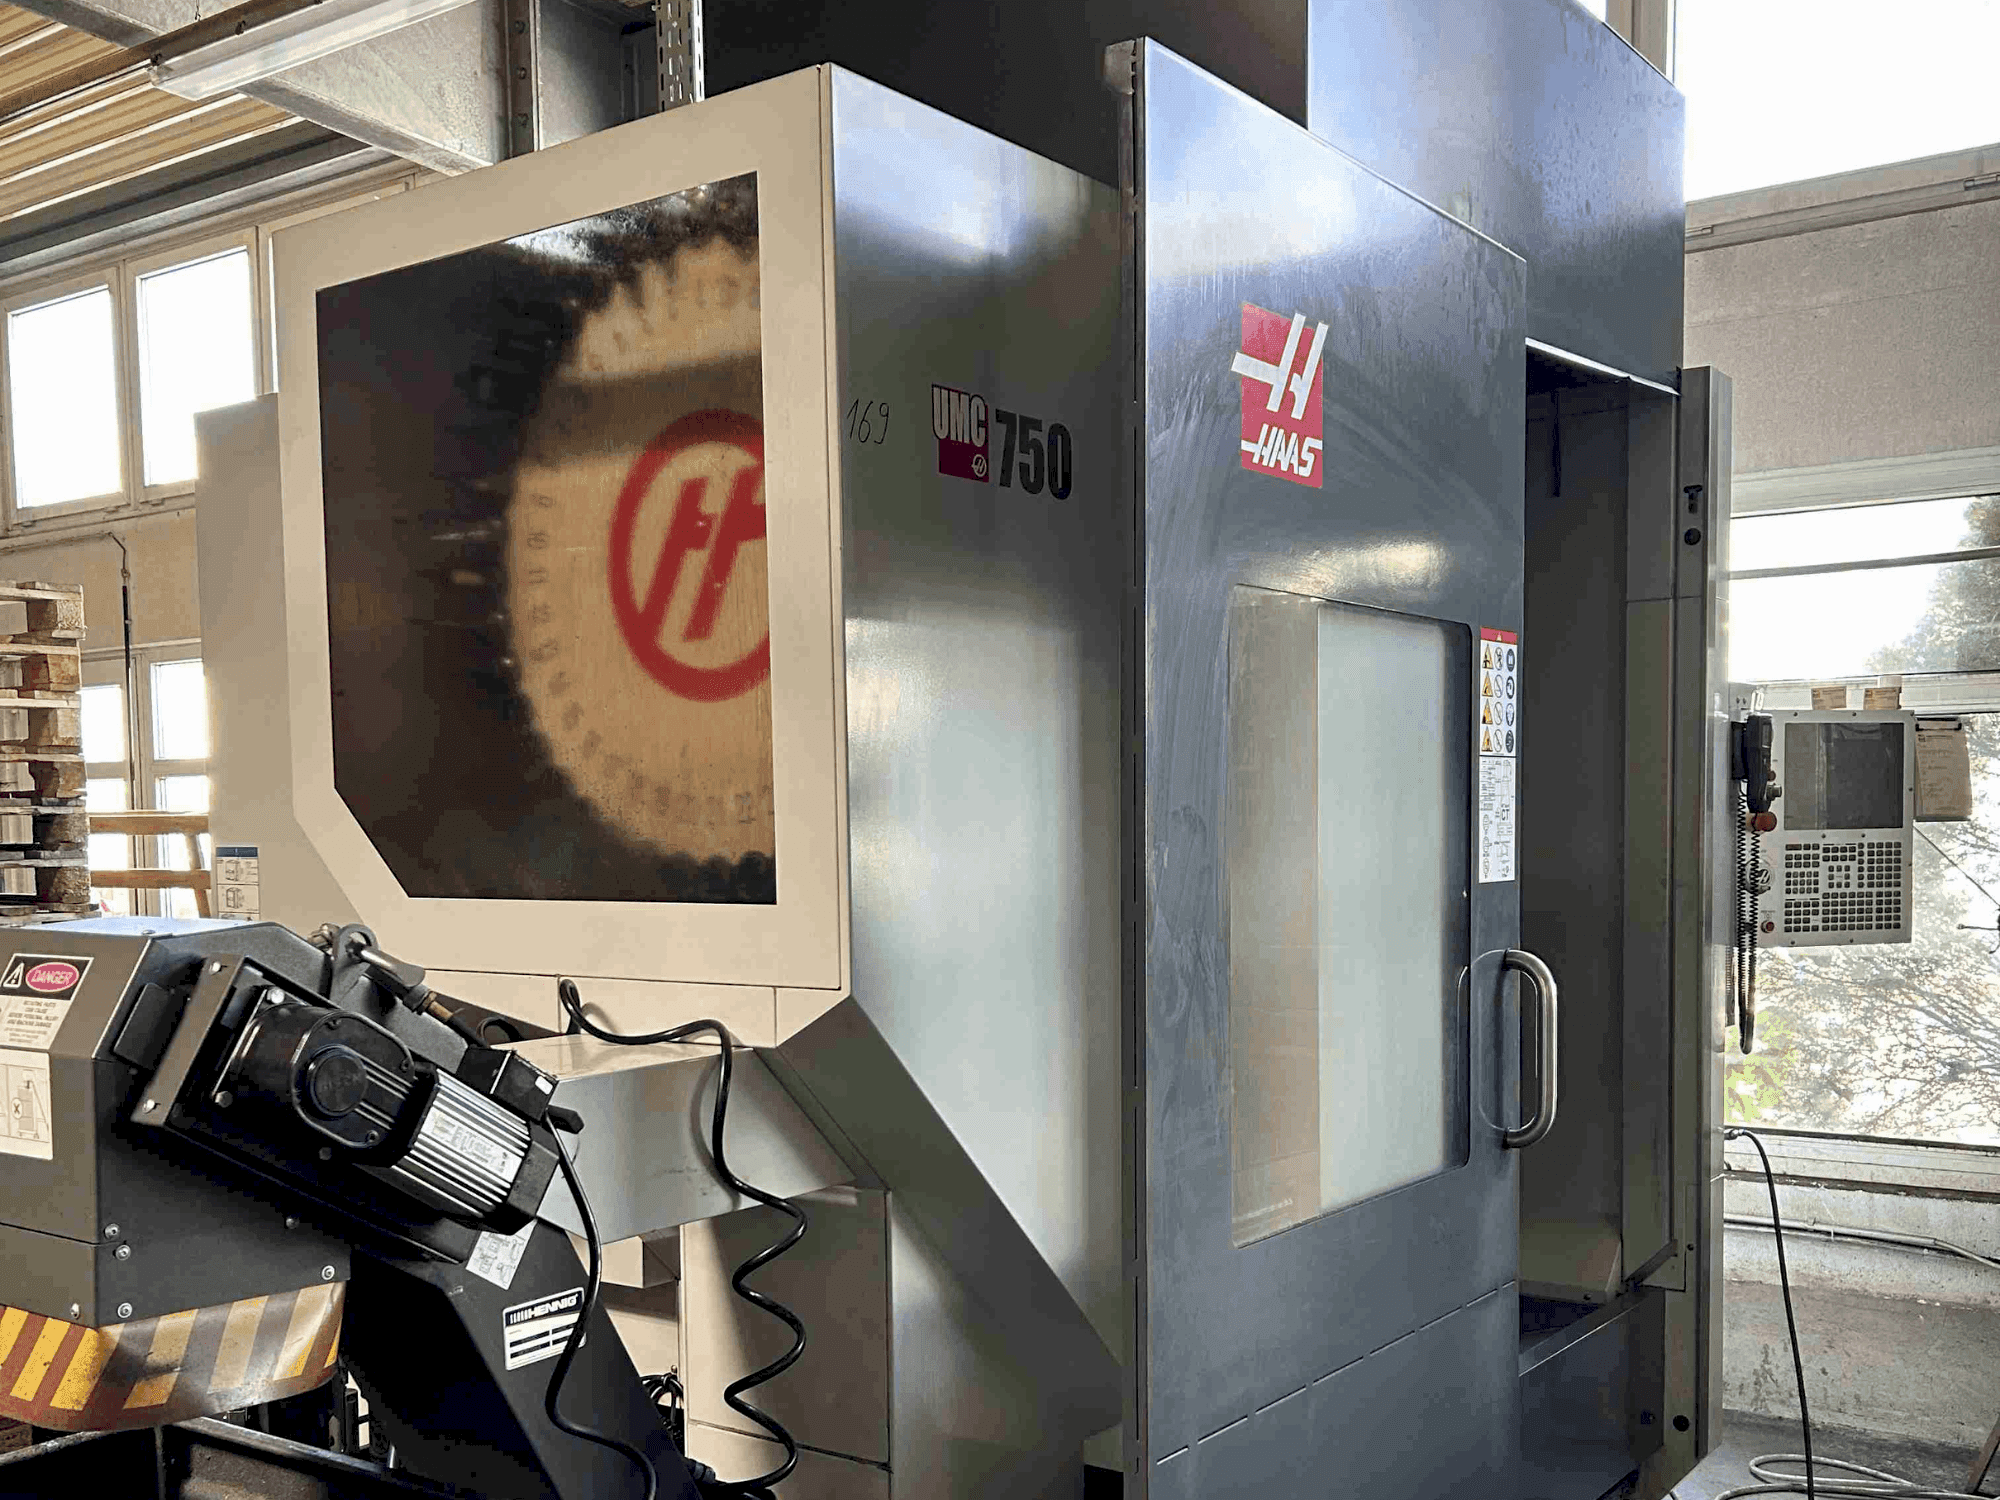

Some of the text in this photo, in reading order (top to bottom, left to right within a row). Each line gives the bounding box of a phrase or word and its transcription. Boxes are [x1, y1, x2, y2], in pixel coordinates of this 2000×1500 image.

[847, 398, 889, 444] 169
[932, 384, 1072, 500] UMC 750
[1241, 423, 1323, 477] HAAS
[31, 969, 73, 985] DANGER
[528, 1297, 578, 1318] HENNIG
